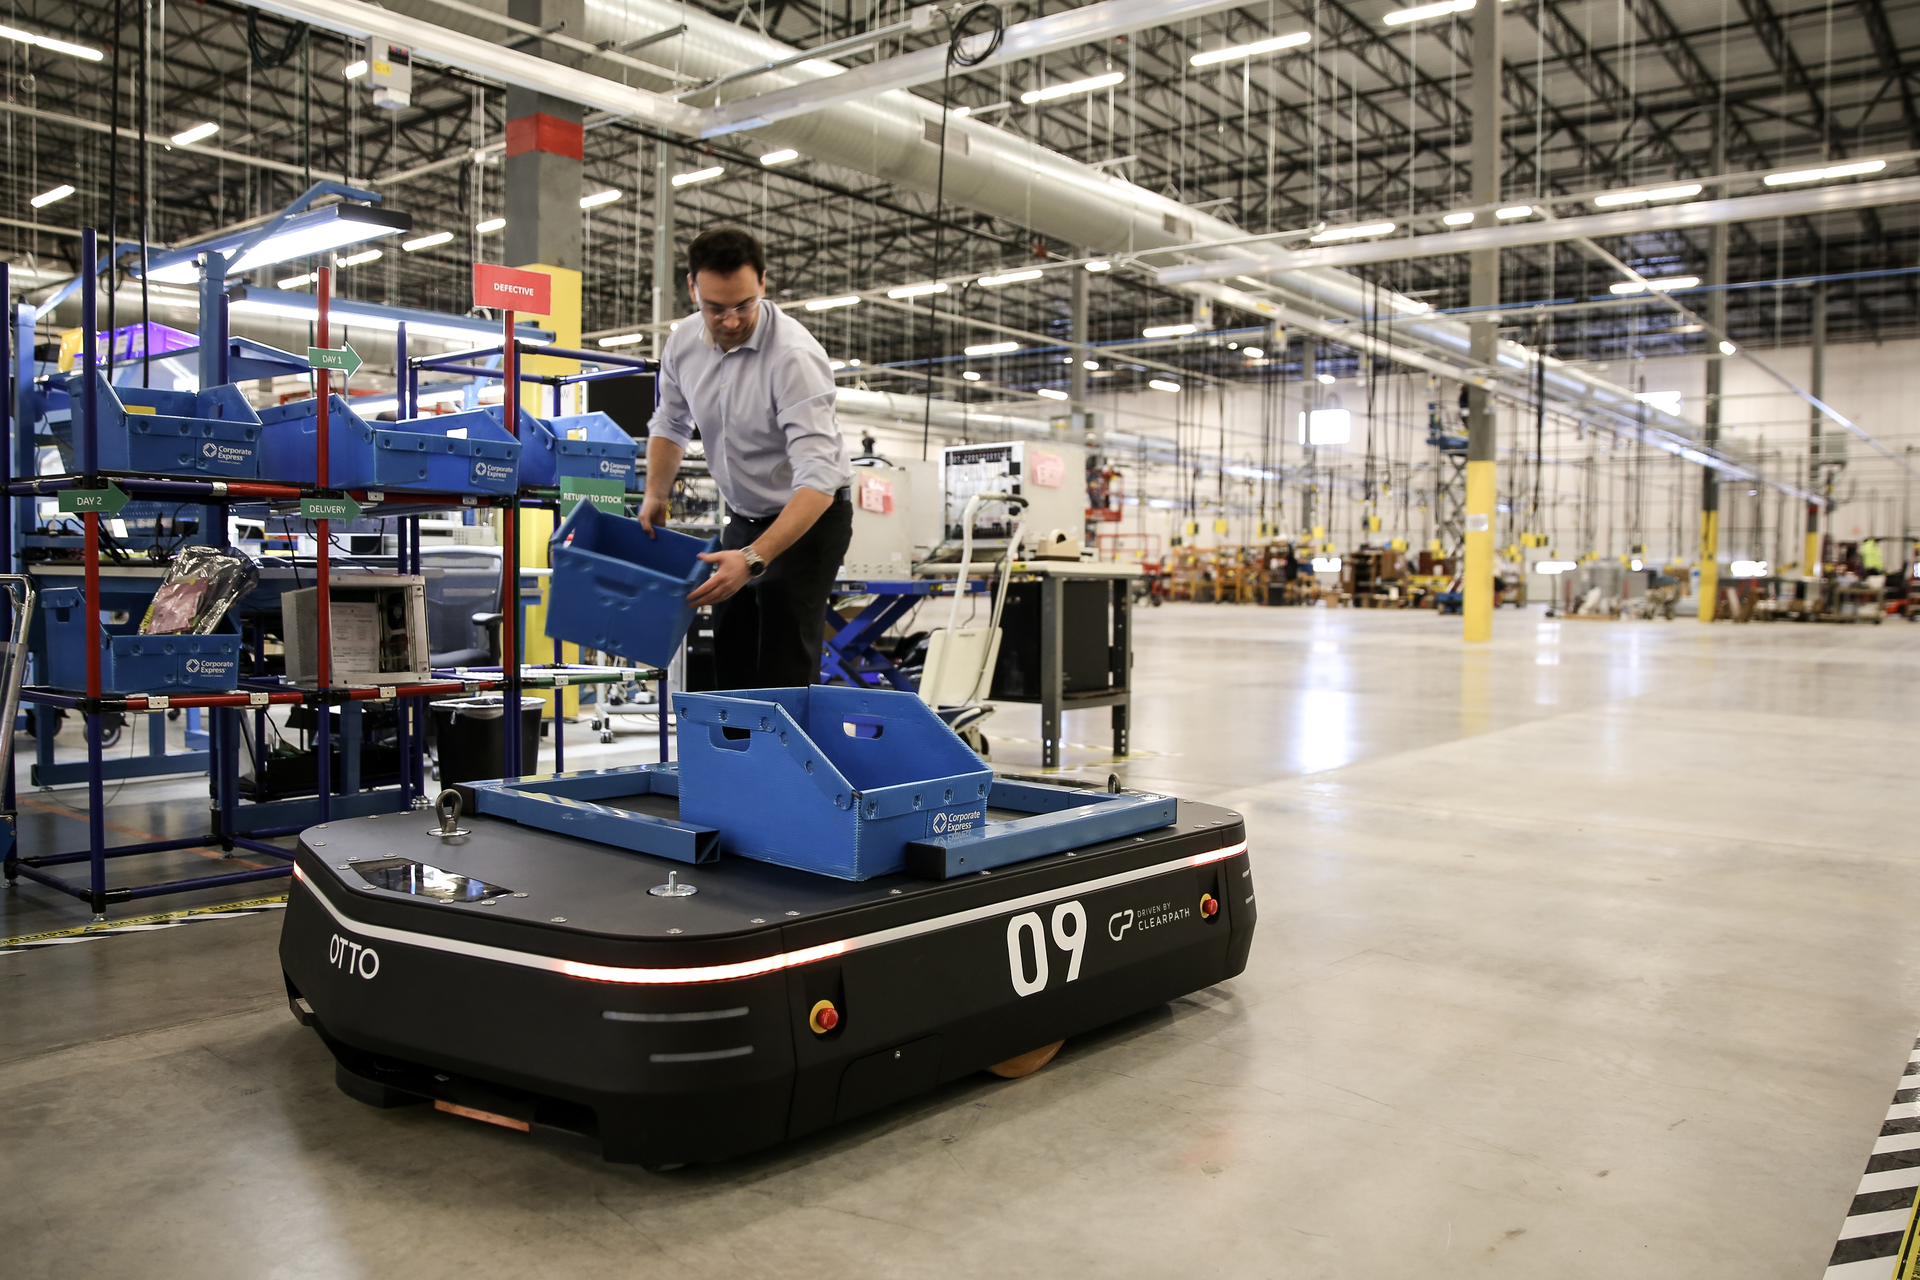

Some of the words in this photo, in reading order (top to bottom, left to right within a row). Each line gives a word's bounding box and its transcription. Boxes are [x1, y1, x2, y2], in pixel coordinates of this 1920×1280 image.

[493, 282, 535, 297] DEFECTIVE
[322, 355, 336, 364] DAY
[338, 356, 342, 365] 1
[218, 445, 252, 456] Corporate
[218, 452, 243, 460] Express
[487, 464, 514, 473] Corporate
[609, 462, 631, 470] Corporate
[76, 497, 95, 506] DAY
[96, 496, 102, 505] 2
[590, 494, 600, 502] TO
[600, 495, 622, 504] STOCK
[309, 504, 346, 514] DELIVERY
[201, 660, 234, 669] Corporate
[948, 810, 981, 823] Corporate
[947, 821, 974, 833] Express
[1136, 905, 1161, 918] DRIVEN
[1162, 902, 1171, 911] BY
[1138, 907, 1190, 931] CLEARPATH
[1007, 900, 1087, 997] 09
[329, 933, 380, 980] OTTO
